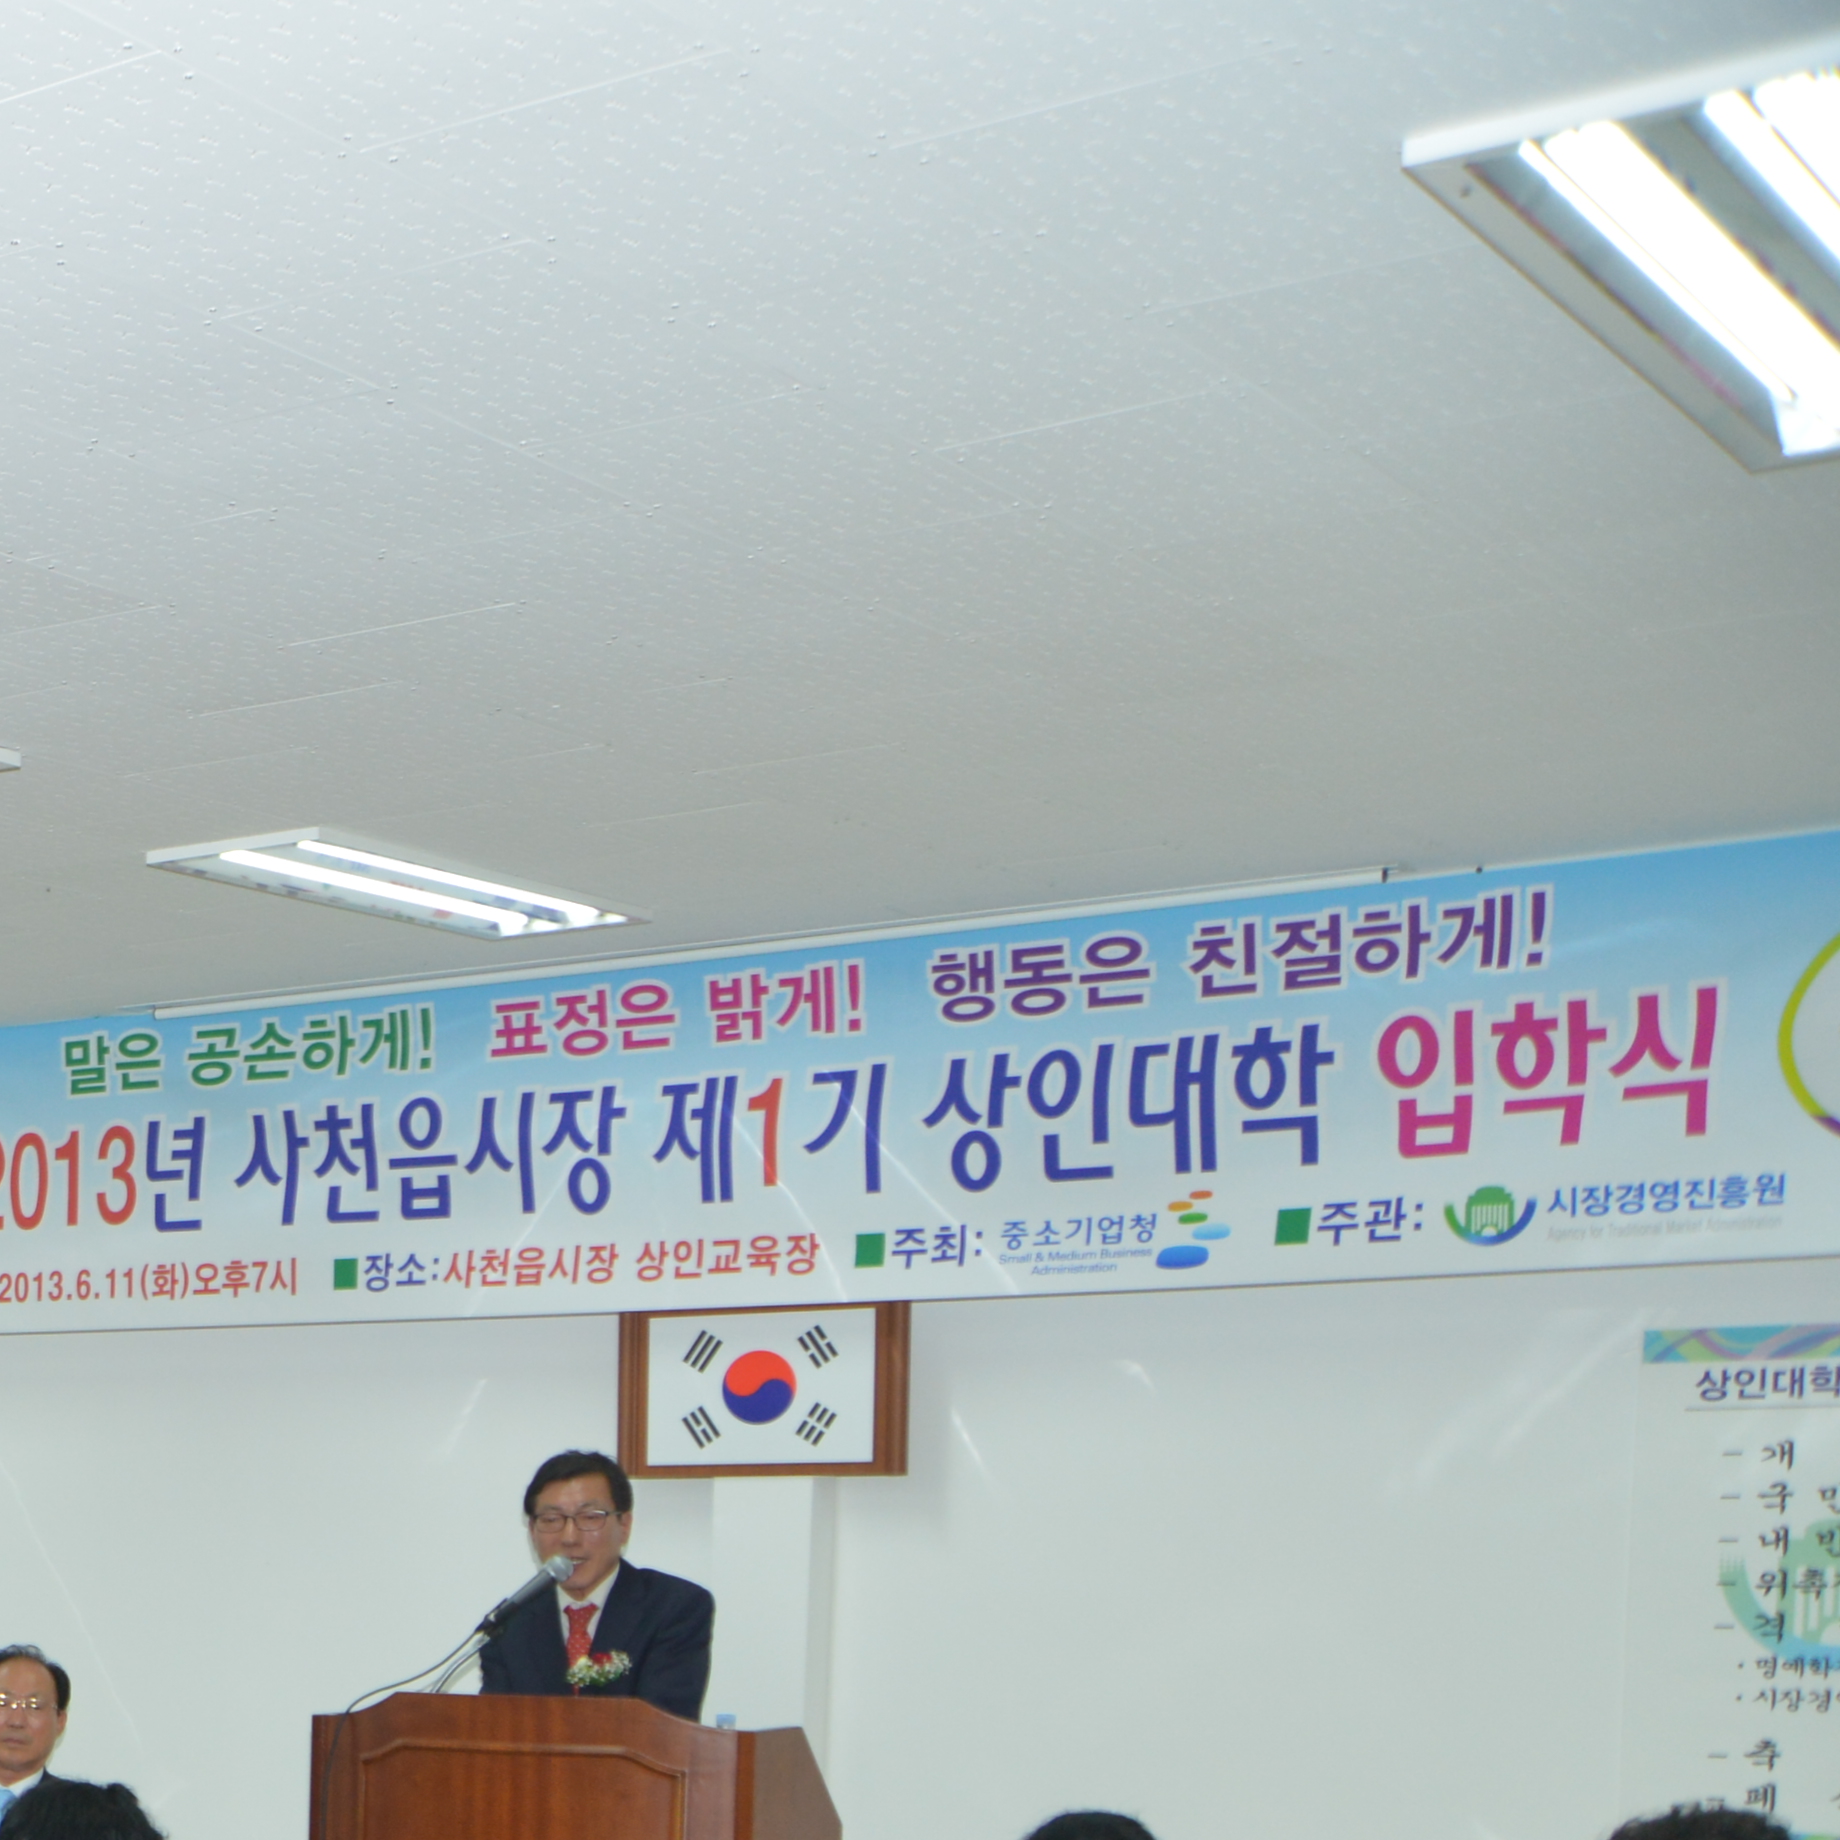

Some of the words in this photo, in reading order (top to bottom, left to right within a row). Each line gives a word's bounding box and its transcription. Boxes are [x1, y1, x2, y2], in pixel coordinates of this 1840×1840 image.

[931, 936, 1152, 1023] 행동은
[1190, 891, 1548, 996] 친절하게!
[490, 984, 676, 1058] 표정은
[709, 964, 862, 1043] 밝게!
[64, 1032, 162, 1095] 말은
[187, 1007, 432, 1087] 공손하게!
[234, 1084, 626, 1226] 사천읍시장
[653, 1061, 888, 1203] 제1기
[922, 1024, 1334, 1194] 상인대학
[1377, 986, 1718, 1159] 입학식
[1547, 1171, 1787, 1217] 시장경영진흥원
[1000, 1213, 1158, 1251] 중소기업청
[1316, 1195, 1424, 1246] 주관:
[635, 1232, 820, 1282] 상인교육장
[891, 1223, 983, 1269] 주최:
[999, 1252, 1032, 1265] Small
[1048, 1250, 1097, 1262] Medium
[1100, 1248, 1153, 1259] Business
[1031, 1262, 1118, 1276] Administration
[1755, 1568, 1840, 1600] 위촉
[1752, 1687, 1840, 1714] 시장경
